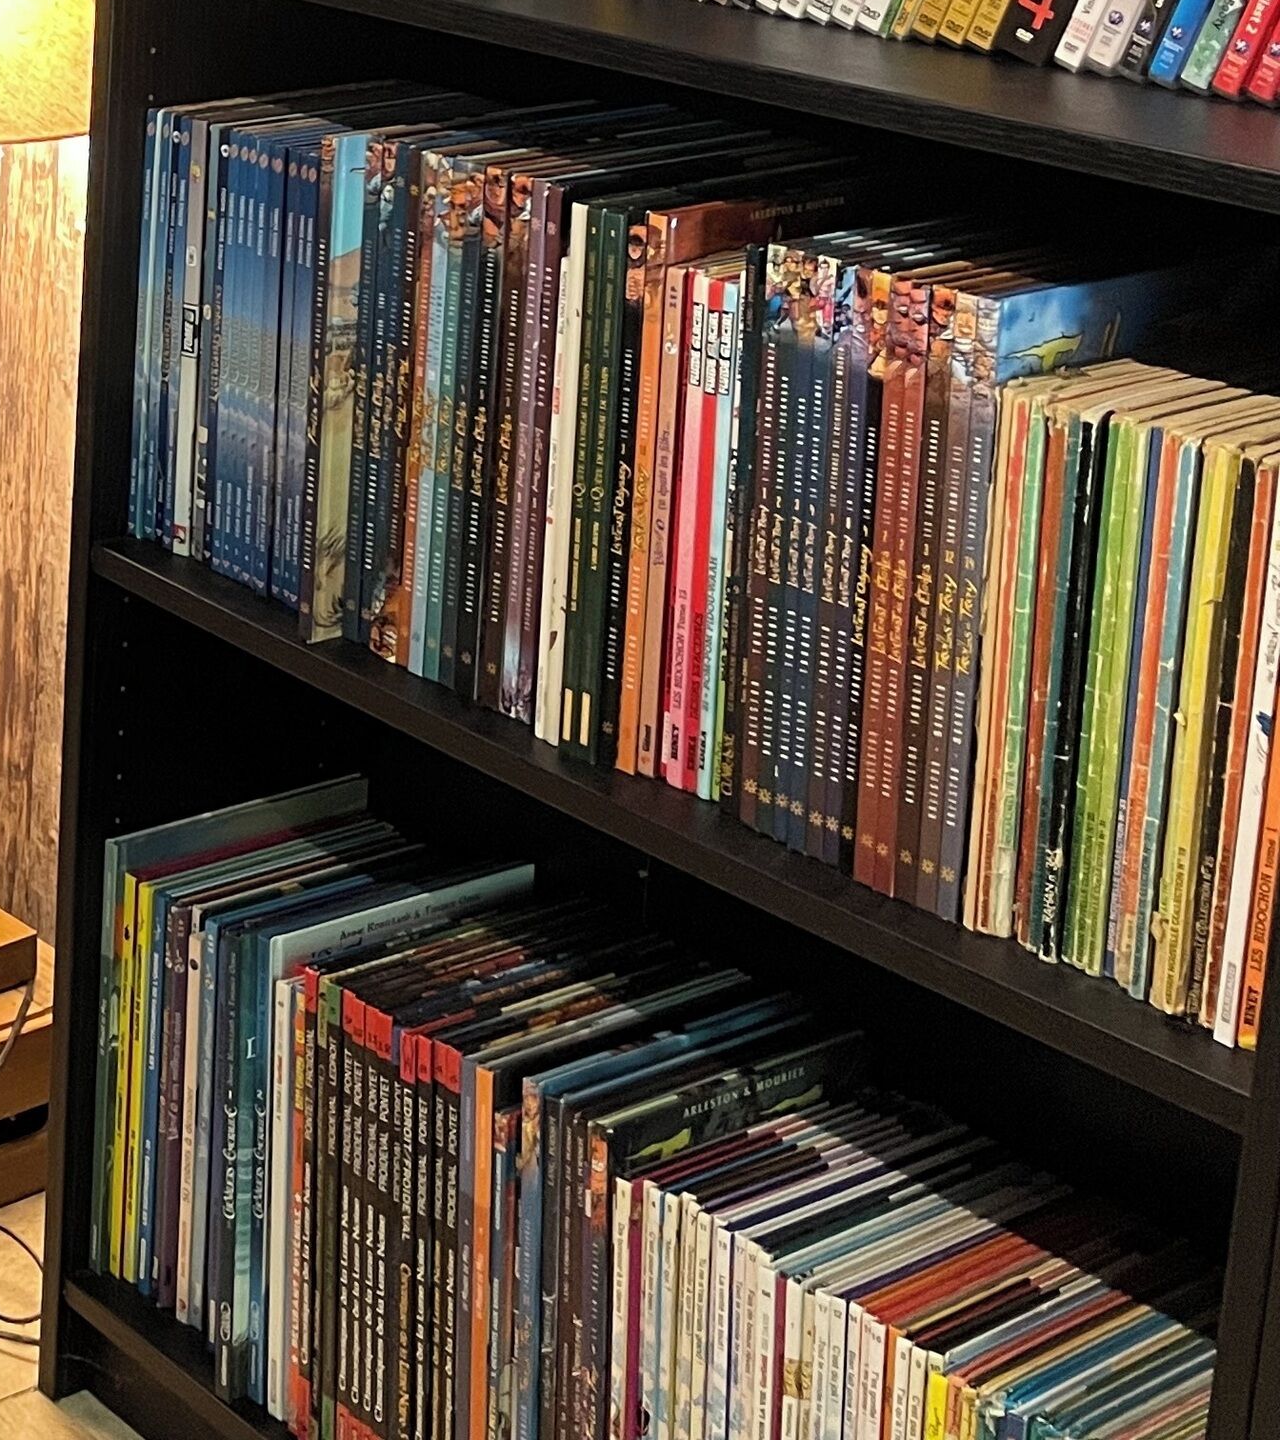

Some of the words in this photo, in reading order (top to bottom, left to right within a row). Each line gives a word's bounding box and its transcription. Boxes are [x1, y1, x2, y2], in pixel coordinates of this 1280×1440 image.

[675, 603, 688, 632] Tome
[673, 634, 686, 687] BIDOCHON
[672, 688, 682, 710] LES
[1264, 840, 1276, 868] tome
[1043, 883, 1056, 923] RAHAN
[1253, 872, 1273, 943] BIDOCHON
[1250, 949, 1264, 972] LES
[1244, 986, 1258, 1026] BINET
[305, 1029, 315, 1088] FROIDEVAL
[342, 1048, 353, 1095] PONTET
[367, 1064, 378, 1113] PONTET
[683, 1090, 740, 1119] ARLESTON
[743, 1086, 751, 1097] &
[304, 1098, 315, 1141] PONTET
[342, 1104, 353, 1164] FROIDEVAL
[447, 1104, 458, 1156] PONTET
[366, 1121, 378, 1183] FROIDEVAL
[446, 1164, 458, 1229] FROIDEVAL
